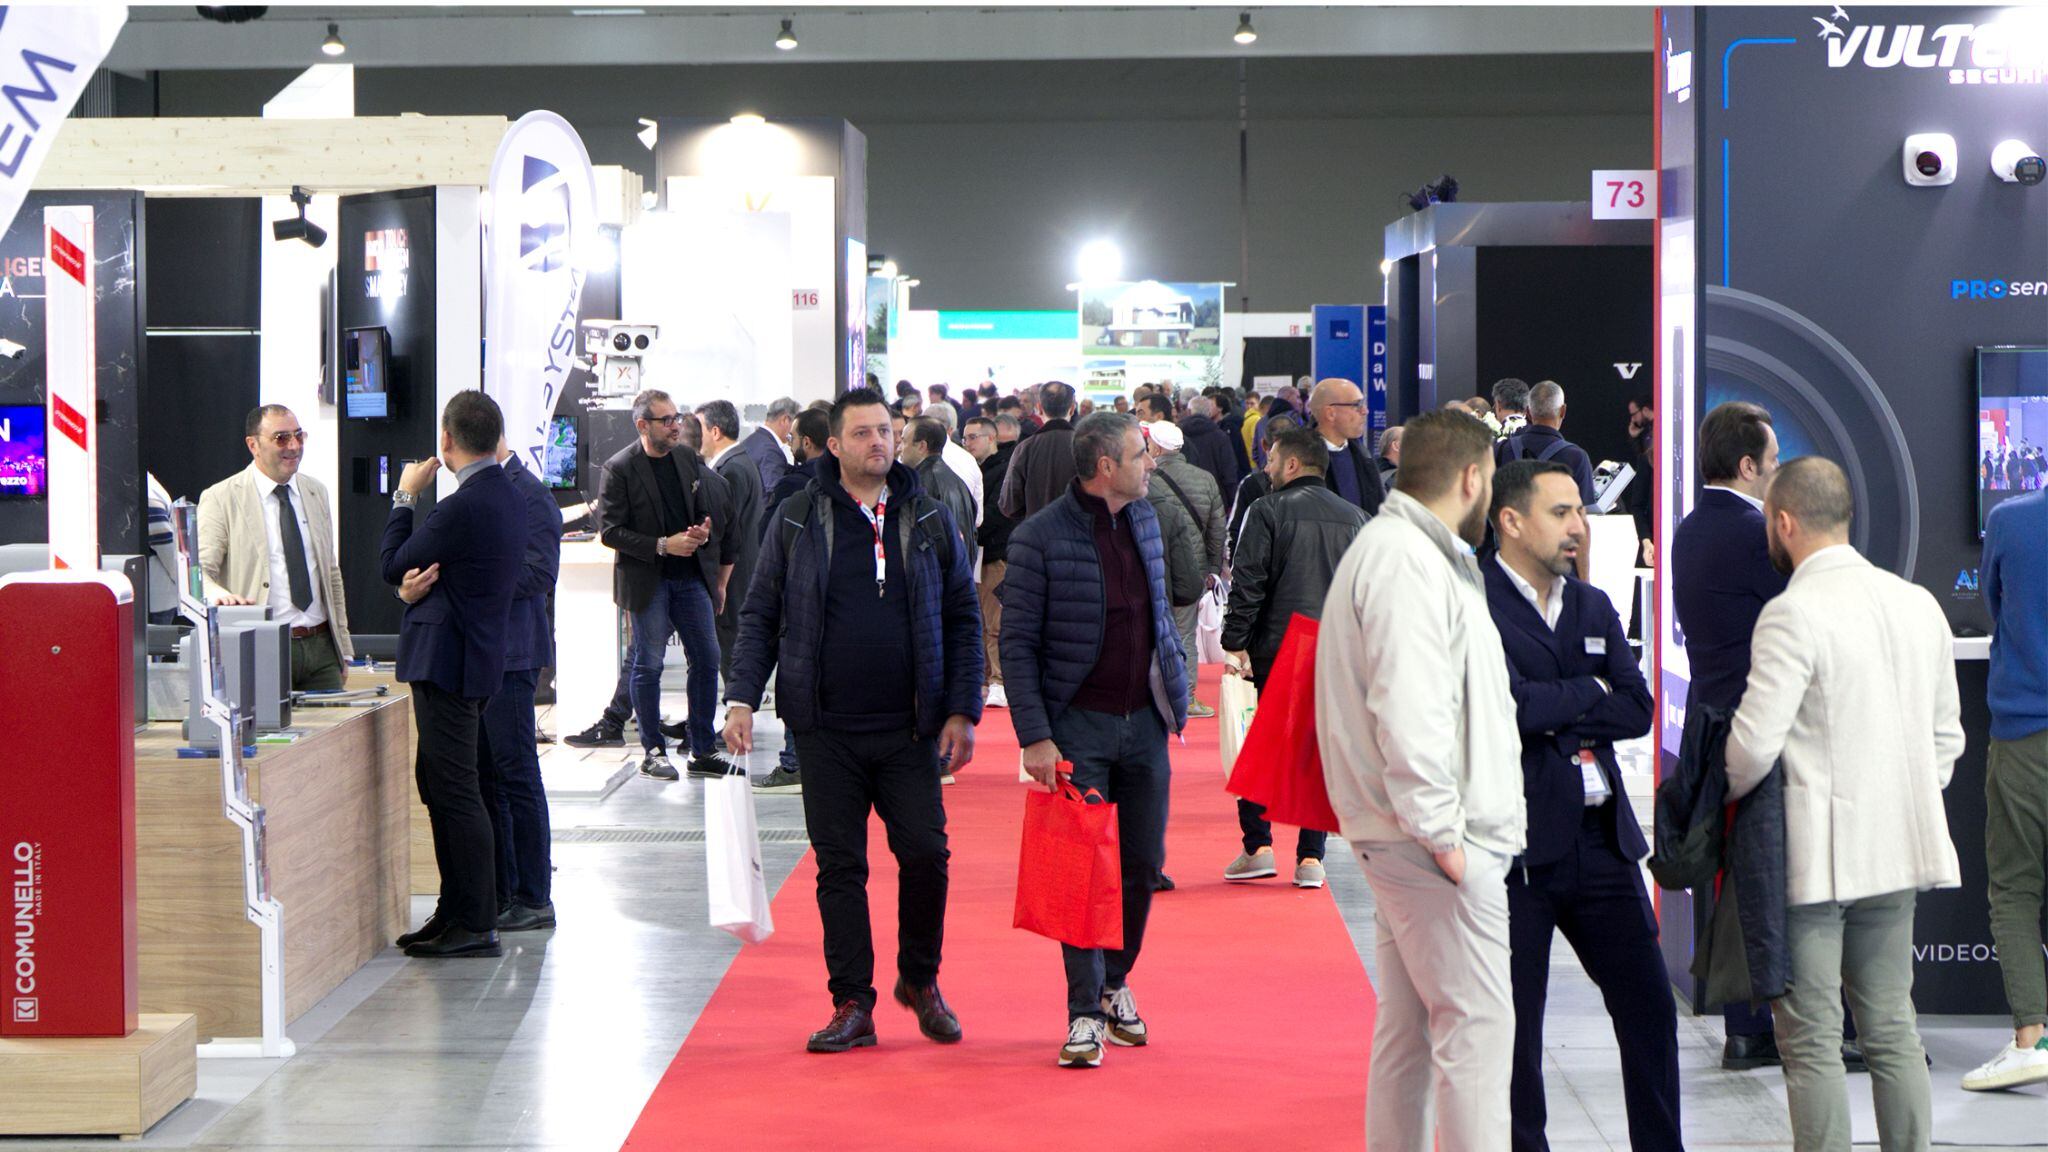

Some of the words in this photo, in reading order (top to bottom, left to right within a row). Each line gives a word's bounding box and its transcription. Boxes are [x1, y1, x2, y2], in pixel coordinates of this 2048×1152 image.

[1606, 181, 1645, 208] 73
[0, 256, 46, 277] IGE
[793, 292, 818, 306] 116
[1951, 279, 2008, 300] PRO
[35, 873, 42, 885] IN
[14, 841, 36, 993] COMUNELLO
